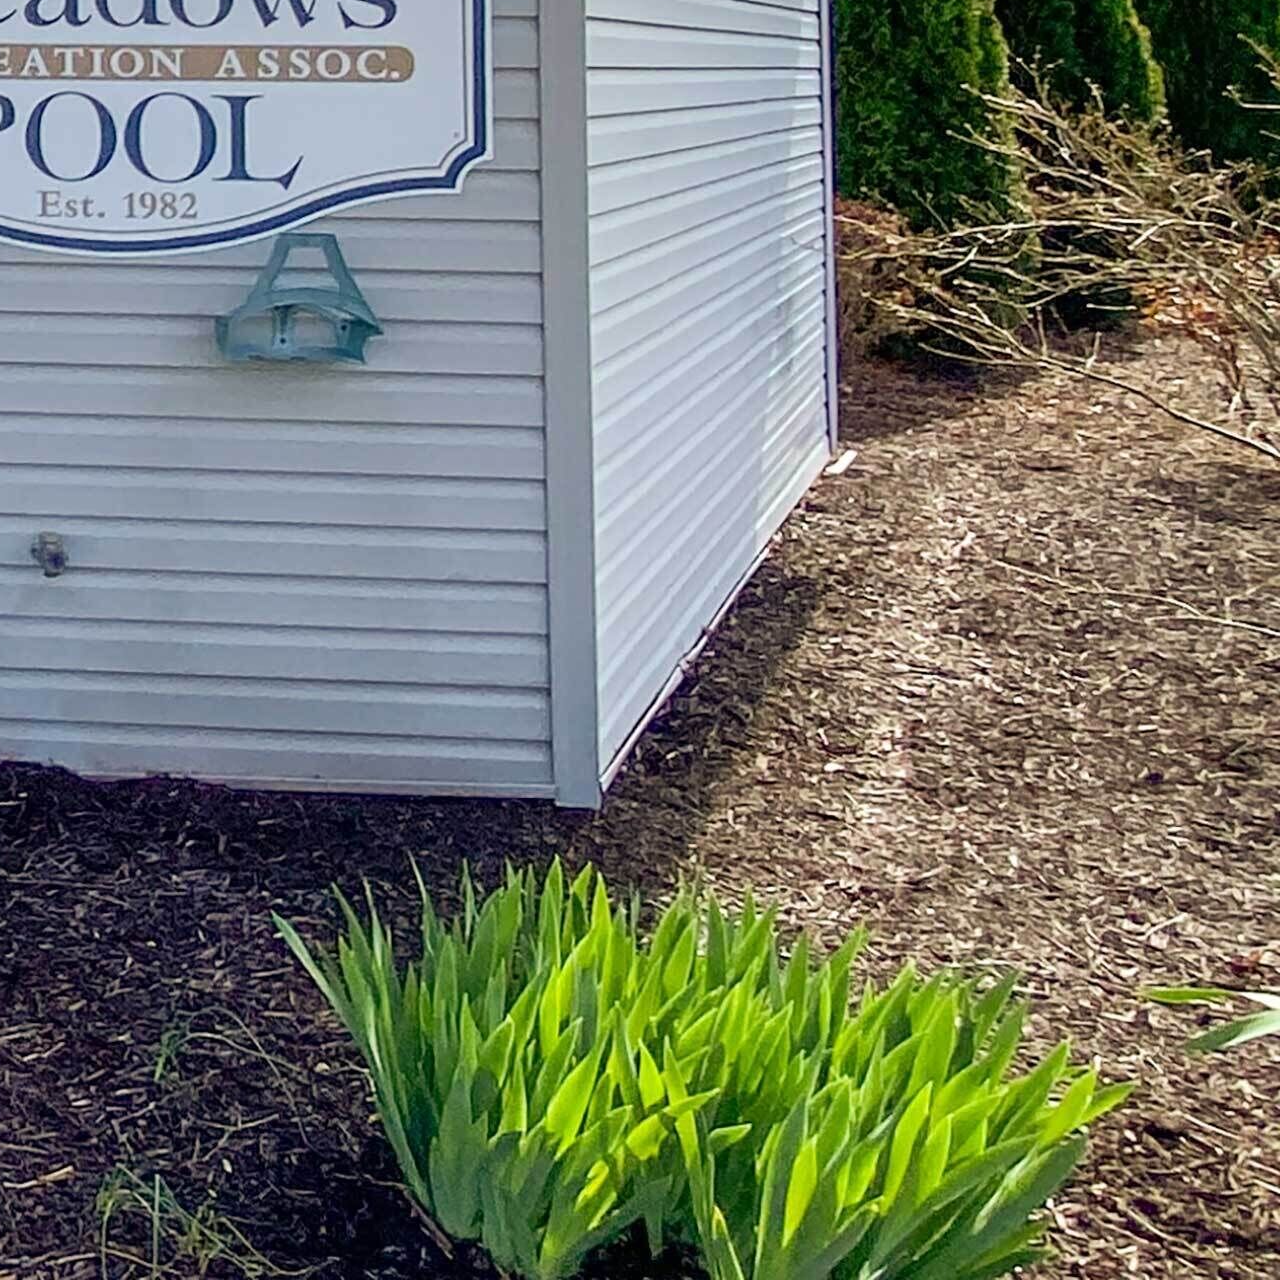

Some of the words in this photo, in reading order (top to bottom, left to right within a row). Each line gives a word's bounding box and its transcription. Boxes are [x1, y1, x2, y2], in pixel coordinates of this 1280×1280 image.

[215, 47, 401, 80] ASSOC.
[36, 190, 106, 219] Est.
[122, 191, 199, 220] 1982
